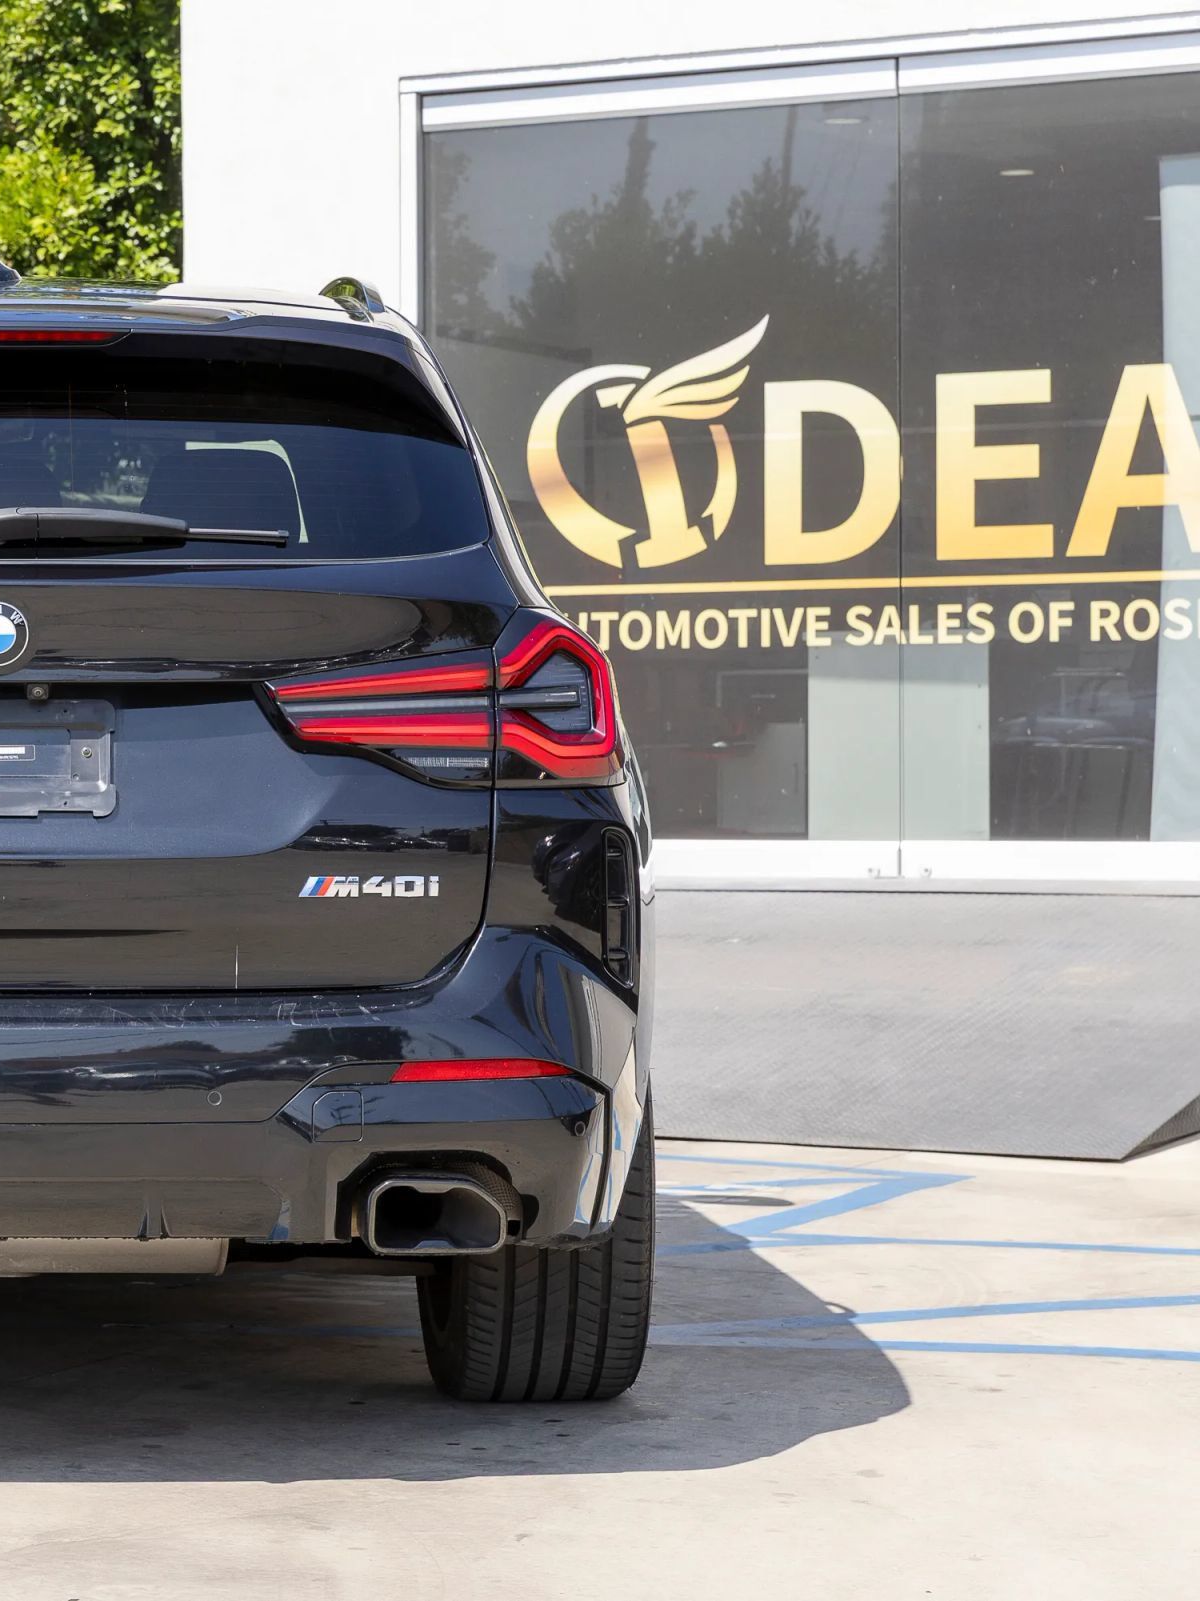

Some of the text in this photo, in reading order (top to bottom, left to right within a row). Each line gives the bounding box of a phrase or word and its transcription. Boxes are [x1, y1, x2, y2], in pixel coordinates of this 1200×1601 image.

[845, 602, 996, 647] SALES
[1008, 601, 1075, 643] OF
[1090, 598, 1200, 642] ROS
[299, 875, 439, 897] M40i
